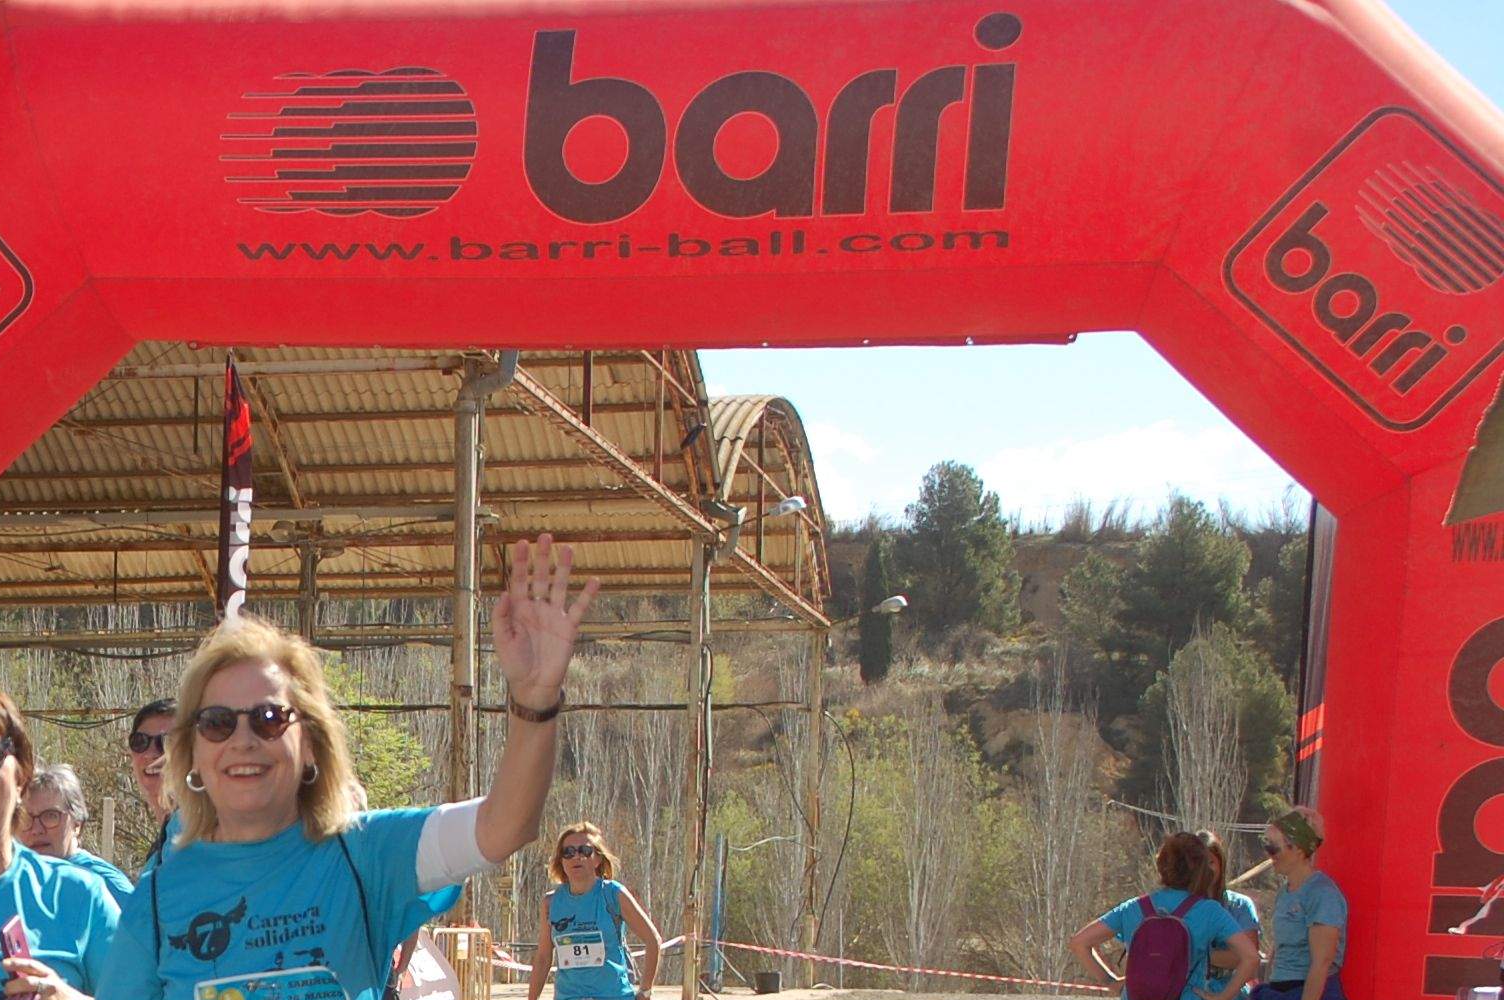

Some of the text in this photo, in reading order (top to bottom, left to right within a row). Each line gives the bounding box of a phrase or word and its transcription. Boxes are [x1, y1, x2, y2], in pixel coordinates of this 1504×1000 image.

[522, 12, 1023, 224] barri
[236, 225, 1011, 262] www.barri-ball.com
[1264, 201, 1467, 397] barri
[247, 905, 320, 930] Carrera
[244, 922, 326, 950] solidaria
[573, 945, 589, 956] 81
